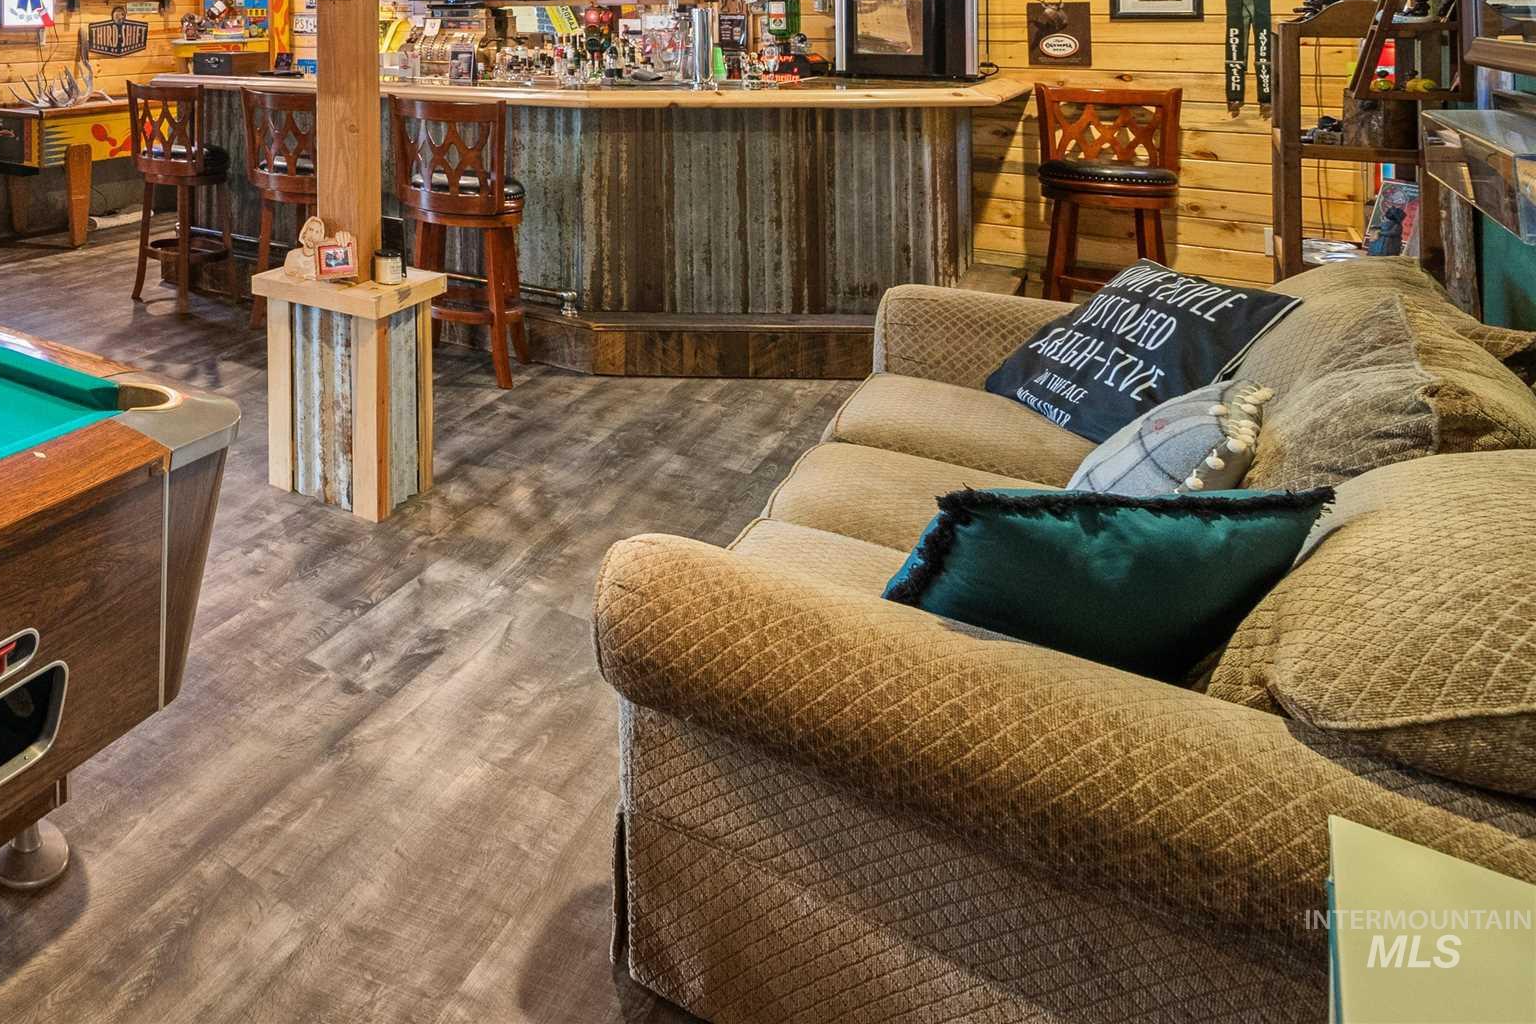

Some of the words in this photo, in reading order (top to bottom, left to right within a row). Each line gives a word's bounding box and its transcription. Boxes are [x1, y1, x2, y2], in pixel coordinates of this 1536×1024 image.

[91, 24, 118, 48] THIRD
[122, 24, 147, 47] SHIFT
[1073, 293, 1131, 331] JUST
[1113, 303, 1177, 351] NEED
[1104, 264, 1169, 297] SOME
[1149, 275, 1248, 322] PEOPLE
[1029, 327, 1060, 353] A
[1043, 327, 1166, 402] HIGH-FIVE
